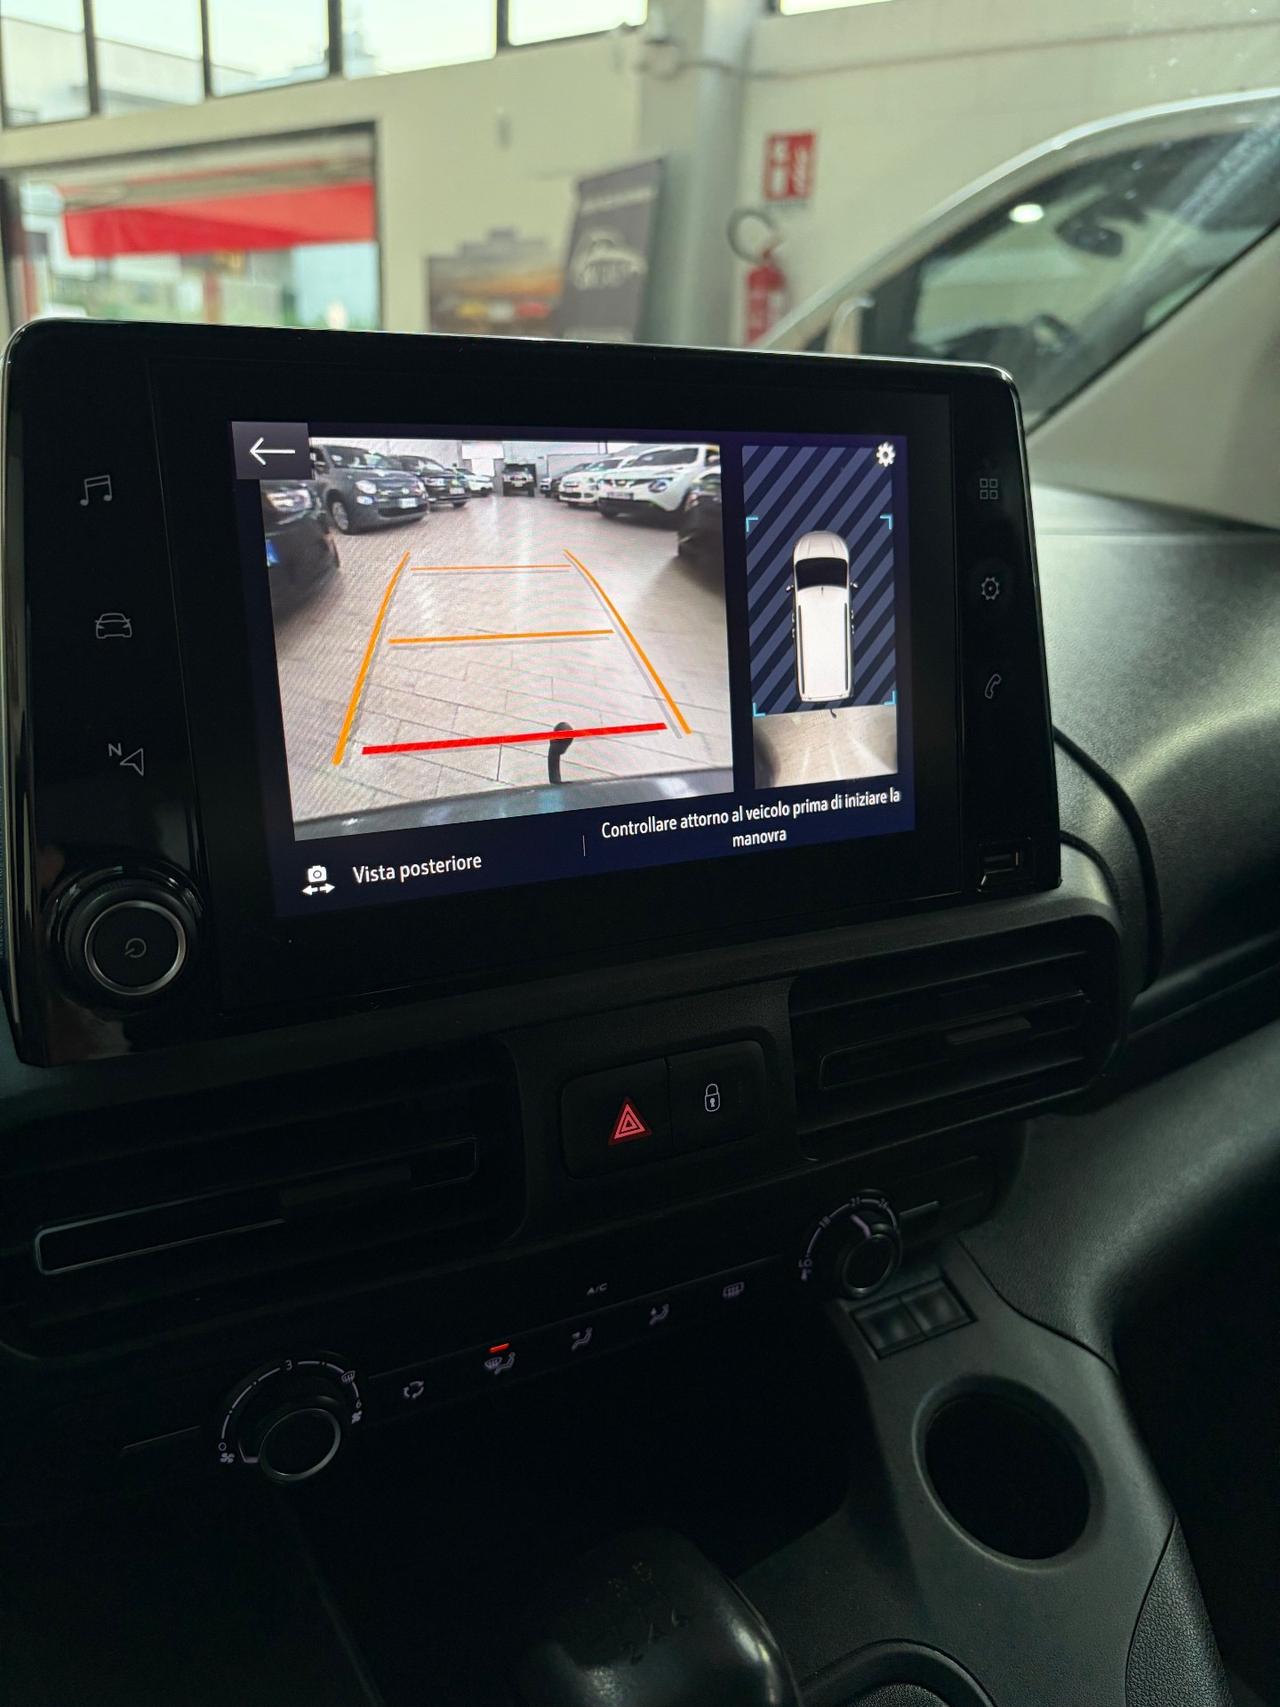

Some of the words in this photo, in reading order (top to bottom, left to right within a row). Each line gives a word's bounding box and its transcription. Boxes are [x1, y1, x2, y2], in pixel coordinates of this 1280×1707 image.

[601, 815, 678, 838] Controllare
[680, 812, 729, 829] attorno
[731, 805, 743, 822] al
[745, 800, 790, 820] veicolo
[792, 799, 828, 819] prima
[830, 793, 842, 810] di
[844, 791, 887, 809] iniziare
[889, 786, 901, 803] la
[732, 829, 787, 848] manovra
[352, 865, 396, 883] Vista
[399, 855, 482, 883] posteriore
[586, 1281, 608, 1296] A/C
